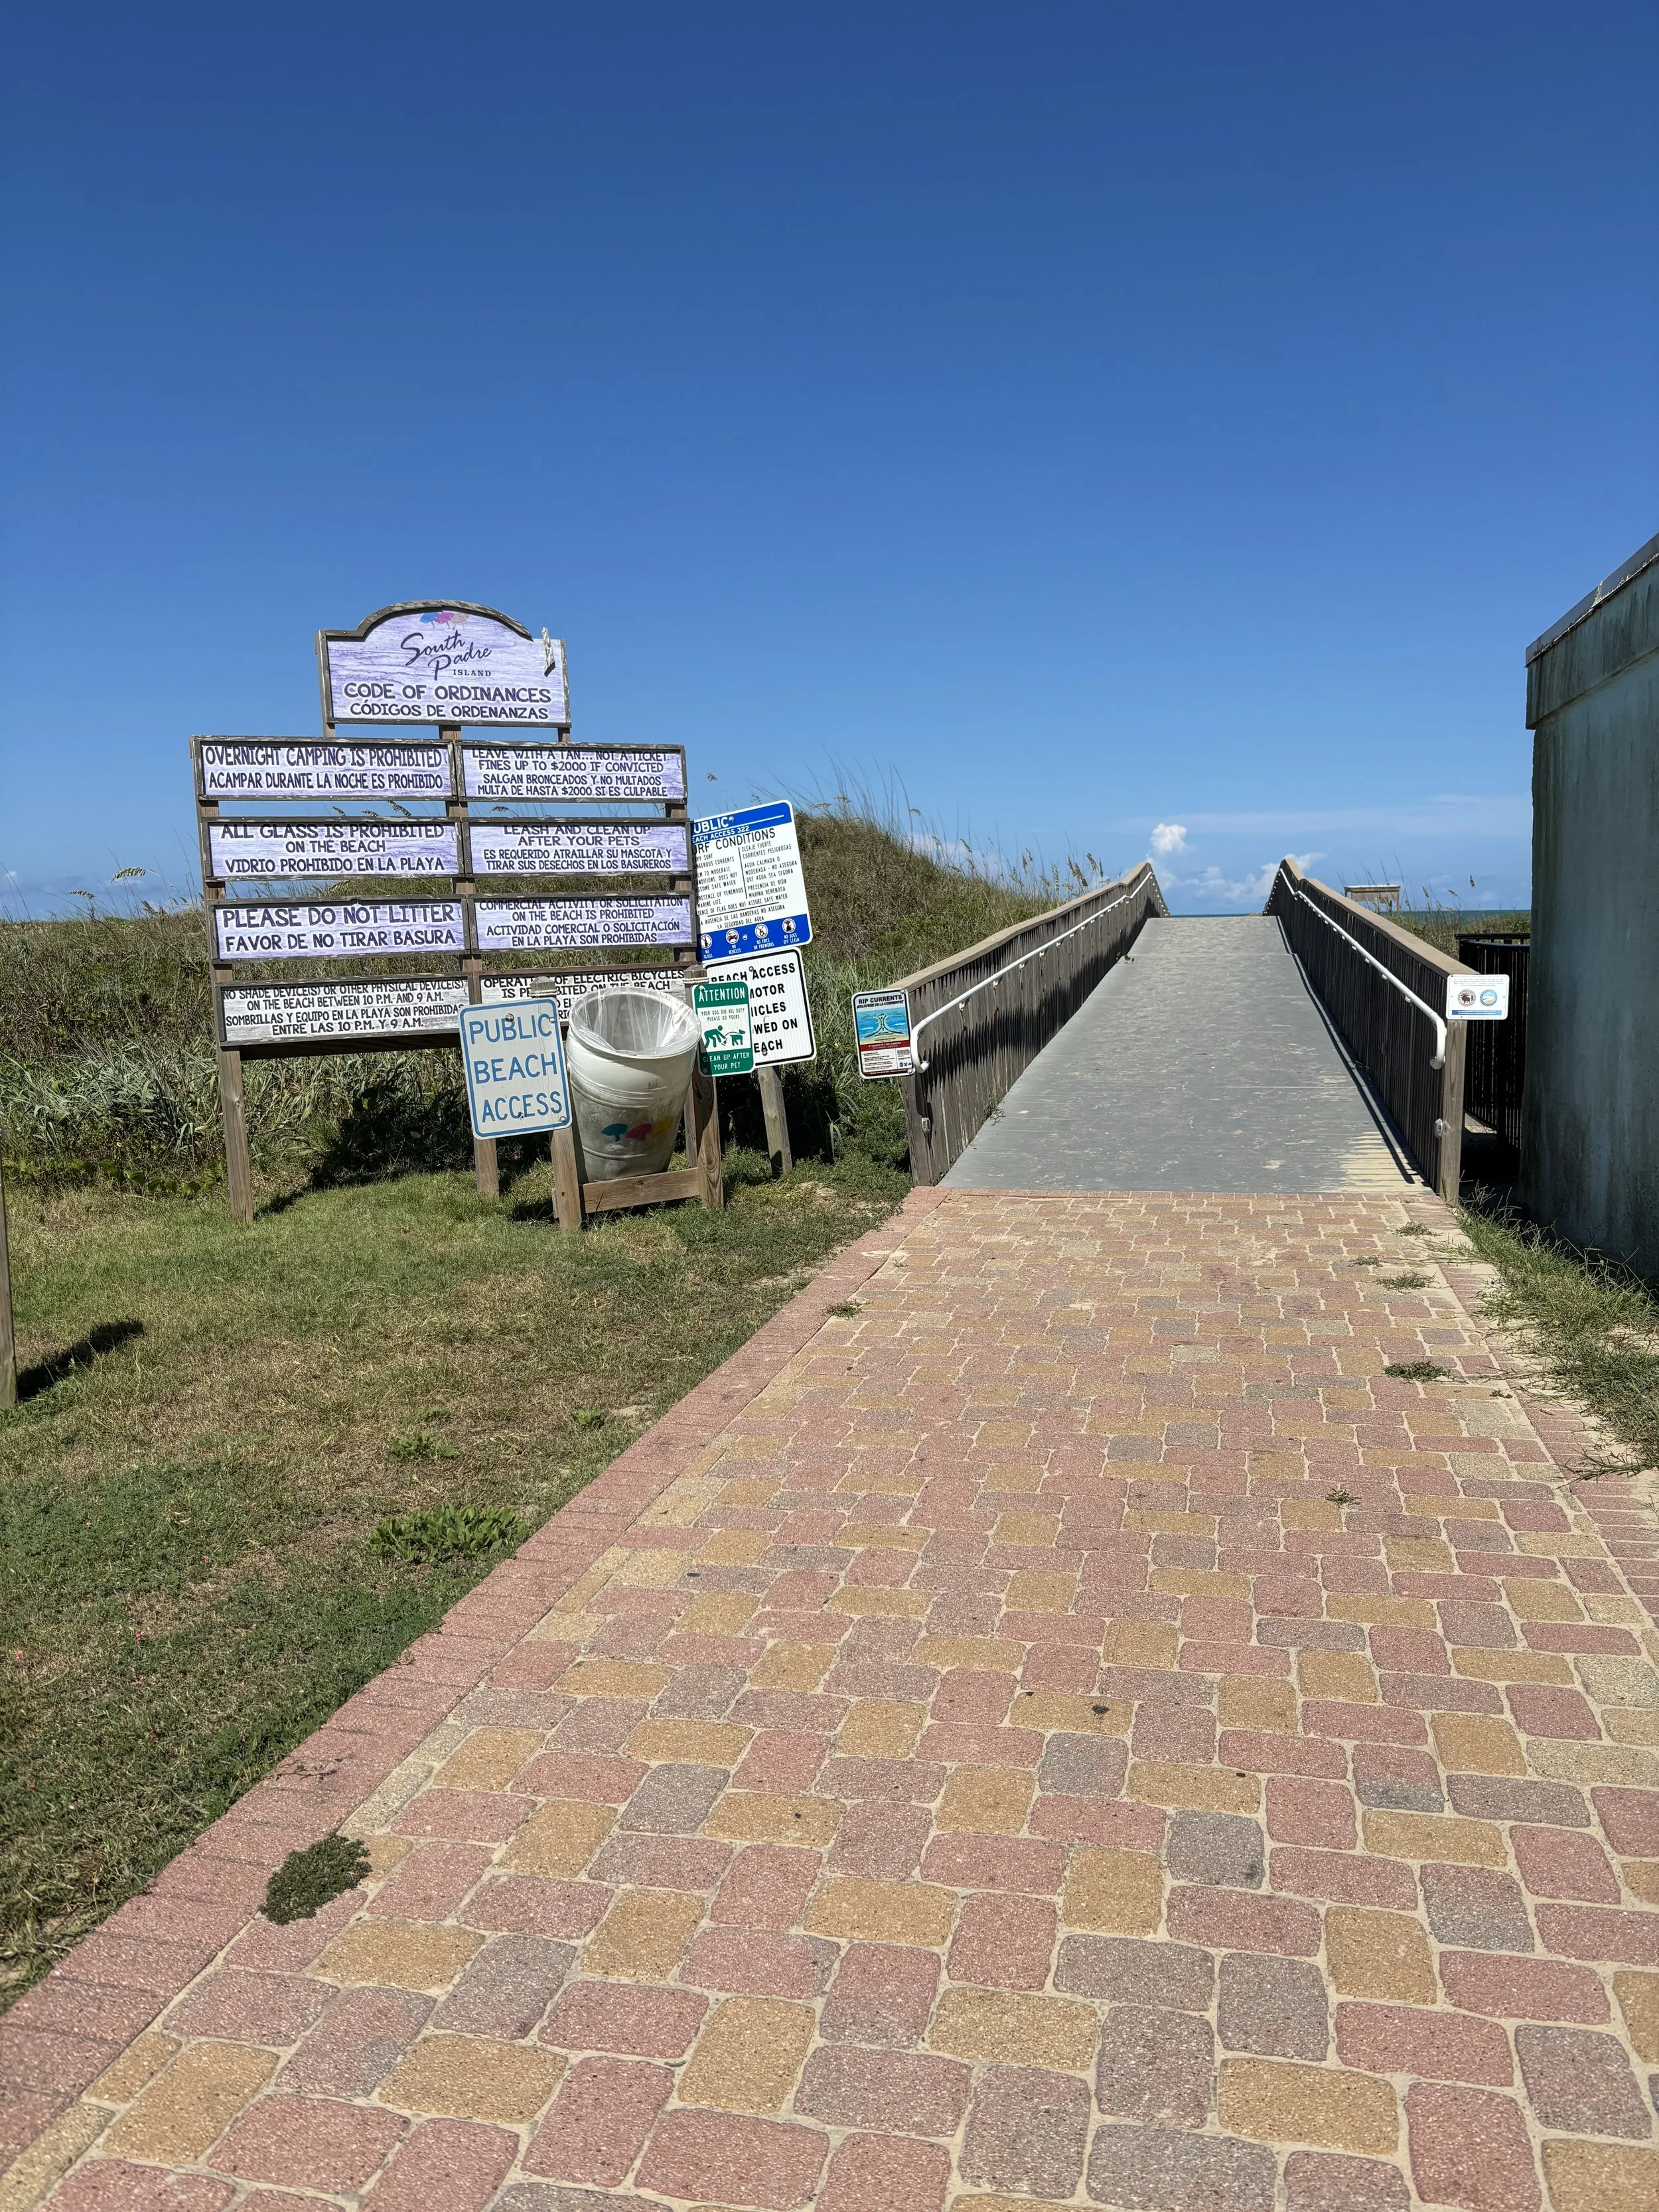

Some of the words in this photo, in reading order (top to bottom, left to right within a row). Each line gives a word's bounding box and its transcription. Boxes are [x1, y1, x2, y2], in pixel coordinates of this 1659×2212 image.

[400, 630, 465, 666] South
[428, 641, 492, 680] Padre
[344, 682, 395, 699] CODE
[403, 685, 426, 700] OF
[435, 686, 551, 703] ORDINANCES
[350, 700, 421, 716] CÓDIGOS
[427, 705, 443, 717] DE
[451, 705, 548, 719] ORDENANZAS
[205, 746, 281, 766] OVERNIGHT
[287, 747, 346, 766] CAMPING
[351, 749, 365, 767] IS
[370, 749, 441, 768] PROHIBITED
[472, 748, 509, 759] LEAVE
[513, 749, 543, 759] WITH
[547, 749, 555, 759] A
[596, 750, 616, 761] NOT
[620, 751, 627, 761] A
[632, 751, 667, 762] TICKET
[479, 760, 511, 771] FINES
[515, 760, 530, 771] UP
[533, 761, 547, 771] TO
[551, 761, 587, 771] $2000
[591, 762, 601, 771] IF
[605, 762, 664, 773] CONVICTED
[209, 772, 263, 788] ACAMPAR
[265, 773, 314, 788] DURANTE
[317, 773, 331, 788] LA
[334, 773, 368, 788] NOCHE
[372, 774, 384, 788] ES
[388, 774, 443, 789] PROHIBIDO
[221, 824, 253, 839] ALL
[259, 824, 319, 839] GLASS
[324, 824, 344, 838] IS
[350, 824, 445, 838] PROHIBITED
[504, 825, 549, 835] LEASH
[555, 825, 582, 835] AND
[587, 825, 630, 835] CLEAN
[634, 826, 651, 834] UP
[693, 816, 729, 834] UBLIC
[518, 836, 561, 846] AFTER
[566, 836, 603, 846] YOUR
[608, 836, 640, 846] PETS
[711, 829, 735, 840] ACCESS
[716, 828, 776, 849] CONDITIONS
[286, 842, 304, 853] ON
[309, 841, 332, 853] THE
[340, 840, 385, 853] BEACH
[226, 859, 275, 873] VIDRIO
[281, 858, 352, 871] PROHIBIDO
[358, 857, 376, 871] EN
[378, 857, 395, 871] LA
[400, 857, 445, 871] PLAYA
[480, 899, 544, 911] COMMERCIAL
[548, 899, 595, 909] ACTIVITY
[599, 898, 613, 908] OR
[616, 897, 683, 909] SOLICITATION
[224, 908, 301, 928] PLEASE
[308, 907, 336, 925] DO
[344, 905, 381, 924] NOT
[388, 904, 455, 923] LITTER
[512, 912, 526, 922] ON
[529, 911, 547, 921] THE
[550, 910, 582, 921] BEACH
[585, 910, 596, 920] IS
[599, 909, 654, 920] PROHIBITED
[487, 924, 541, 936] ACTIVIDAD
[545, 923, 599, 934] COMERCIAL
[604, 923, 610, 932] O
[613, 919, 680, 932] SOLICITACIÓN
[226, 934, 282, 952] FAVOR
[288, 934, 308, 950] DE
[313, 933, 334, 948] NO
[339, 930, 388, 947] TIRAR
[394, 929, 457, 946] BASURA
[512, 936, 525, 946] EN
[528, 936, 540, 946] LA
[543, 934, 577, 945] PLAYA
[579, 934, 599, 944] SON
[601, 932, 658, 944] PROHIBIDAS
[554, 975, 568, 984] OF
[573, 972, 628, 984] ELECTRIC
[631, 970, 684, 981] BICYCLES
[753, 963, 795, 980] ACCESS
[222, 990, 236, 1000] NO
[239, 988, 269, 999] SHADE
[273, 986, 321, 998] DEVICE(S)
[323, 985, 336, 995] OR
[340, 984, 368, 995] OTHER
[371, 982, 417, 994] PHYSICAL
[419, 980, 464, 992] DEVICE(S)
[502, 988, 516, 998] IS
[699, 988, 745, 1002] ATTENTION
[247, 1001, 260, 1011] ON
[263, 999, 281, 1011] THE
[283, 997, 314, 1009] BEACH
[317, 995, 360, 1007] BETWEEN
[364, 995, 374, 1005] 10
[376, 994, 394, 1004] P.M.
[396, 993, 413, 1003] AND
[417, 993, 423, 1002] 9
[426, 992, 443, 1001] A.M.
[469, 1013, 552, 1044] PUBLIC
[782, 1018, 798, 1029] ON
[474, 1052, 557, 1084] BEACH
[482, 1091, 563, 1123] ACCESS
